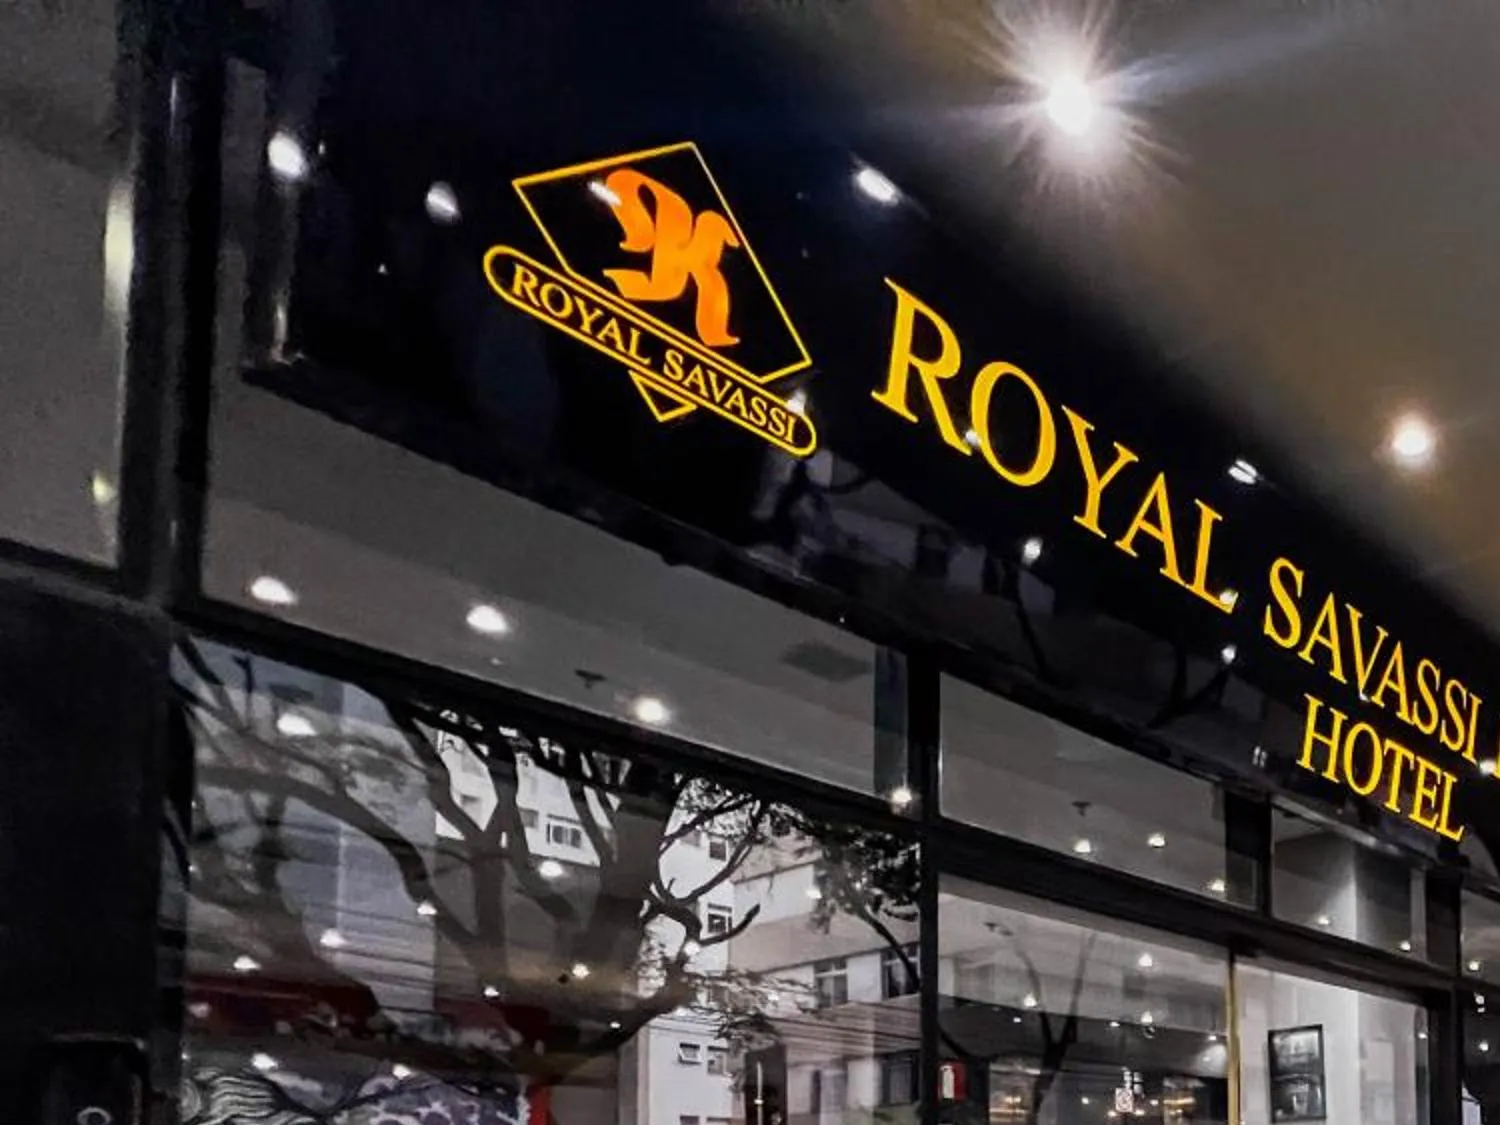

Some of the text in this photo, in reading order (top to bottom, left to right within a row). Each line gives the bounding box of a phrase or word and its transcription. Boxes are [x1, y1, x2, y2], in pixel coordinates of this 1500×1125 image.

[511, 264, 799, 444] ROYAL SAVASSI
[870, 276, 1237, 614] ROYAL
[1263, 557, 1483, 762] SAVASSI
[1297, 692, 1464, 842] HOTEL
